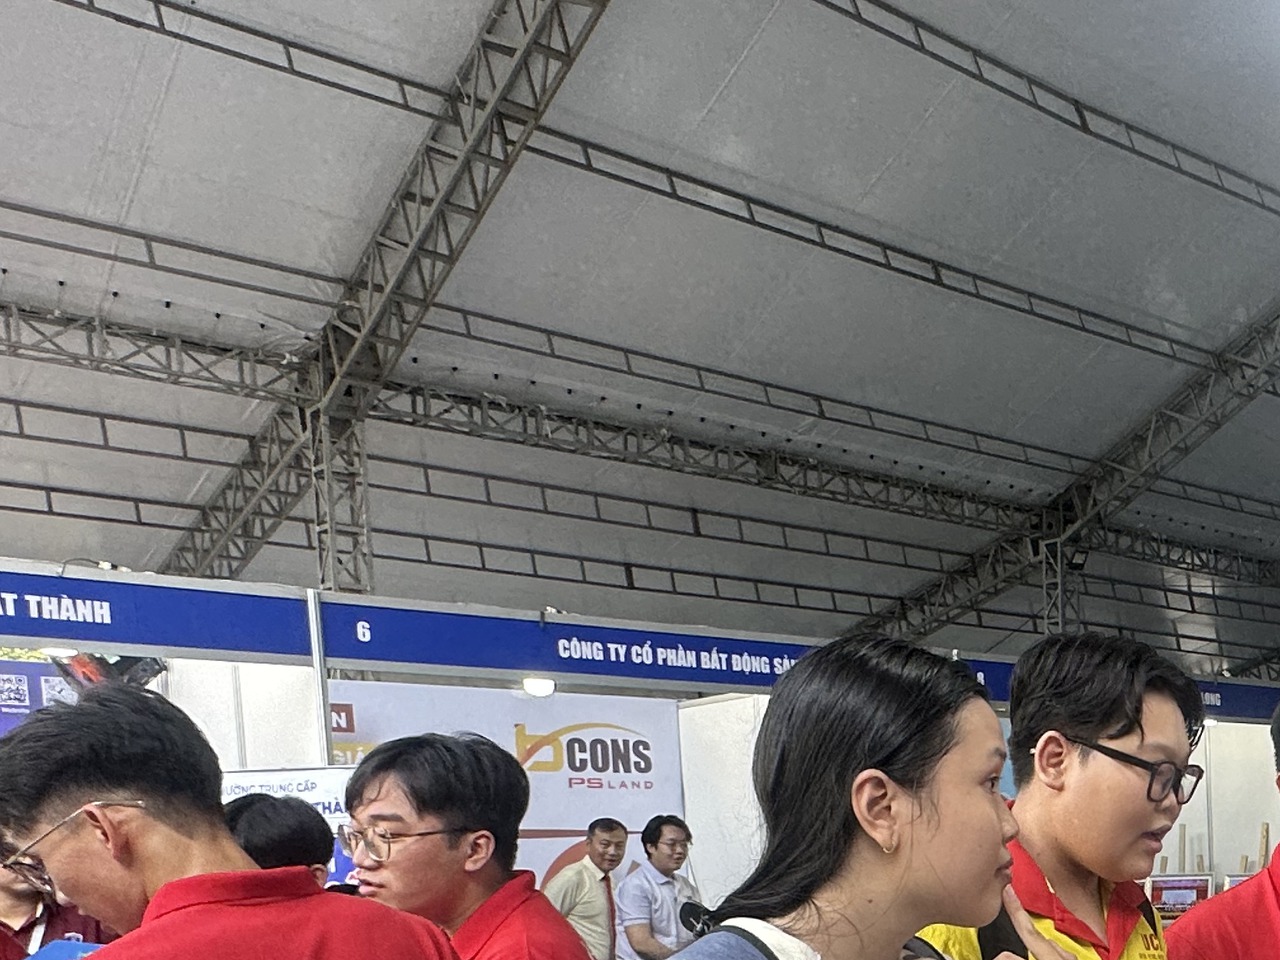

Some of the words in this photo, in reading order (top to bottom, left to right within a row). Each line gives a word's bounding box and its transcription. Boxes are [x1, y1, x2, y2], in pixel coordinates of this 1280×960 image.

[25, 594, 111, 624] THÀNH
[357, 621, 371, 642] 6
[558, 637, 603, 660] CÔNG
[607, 643, 627, 662] TY
[731, 652, 770, 675] ĐỘNG
